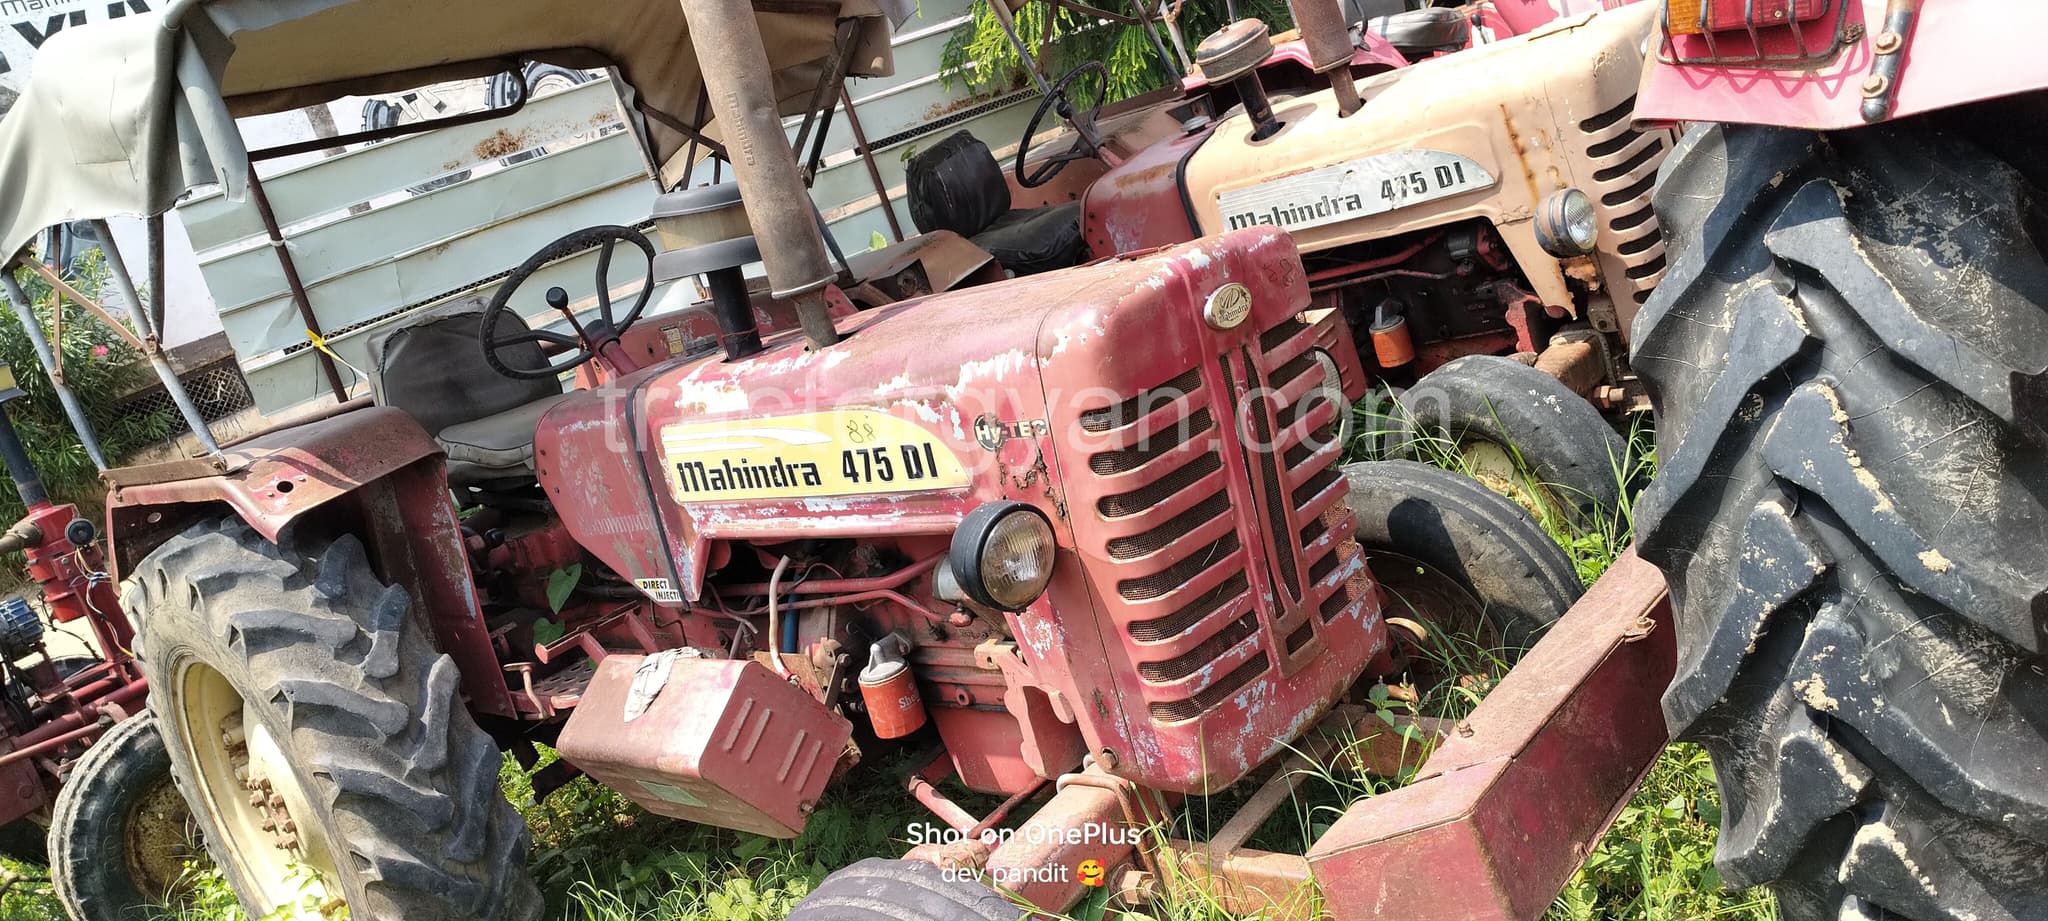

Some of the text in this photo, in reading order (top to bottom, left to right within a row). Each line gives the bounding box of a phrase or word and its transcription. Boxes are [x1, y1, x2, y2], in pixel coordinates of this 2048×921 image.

[1381, 171, 1427, 201] 475
[1434, 161, 1465, 188] DI
[676, 442, 938, 493] Mahindra 475 DI
[643, 580, 668, 589] DIRECT
